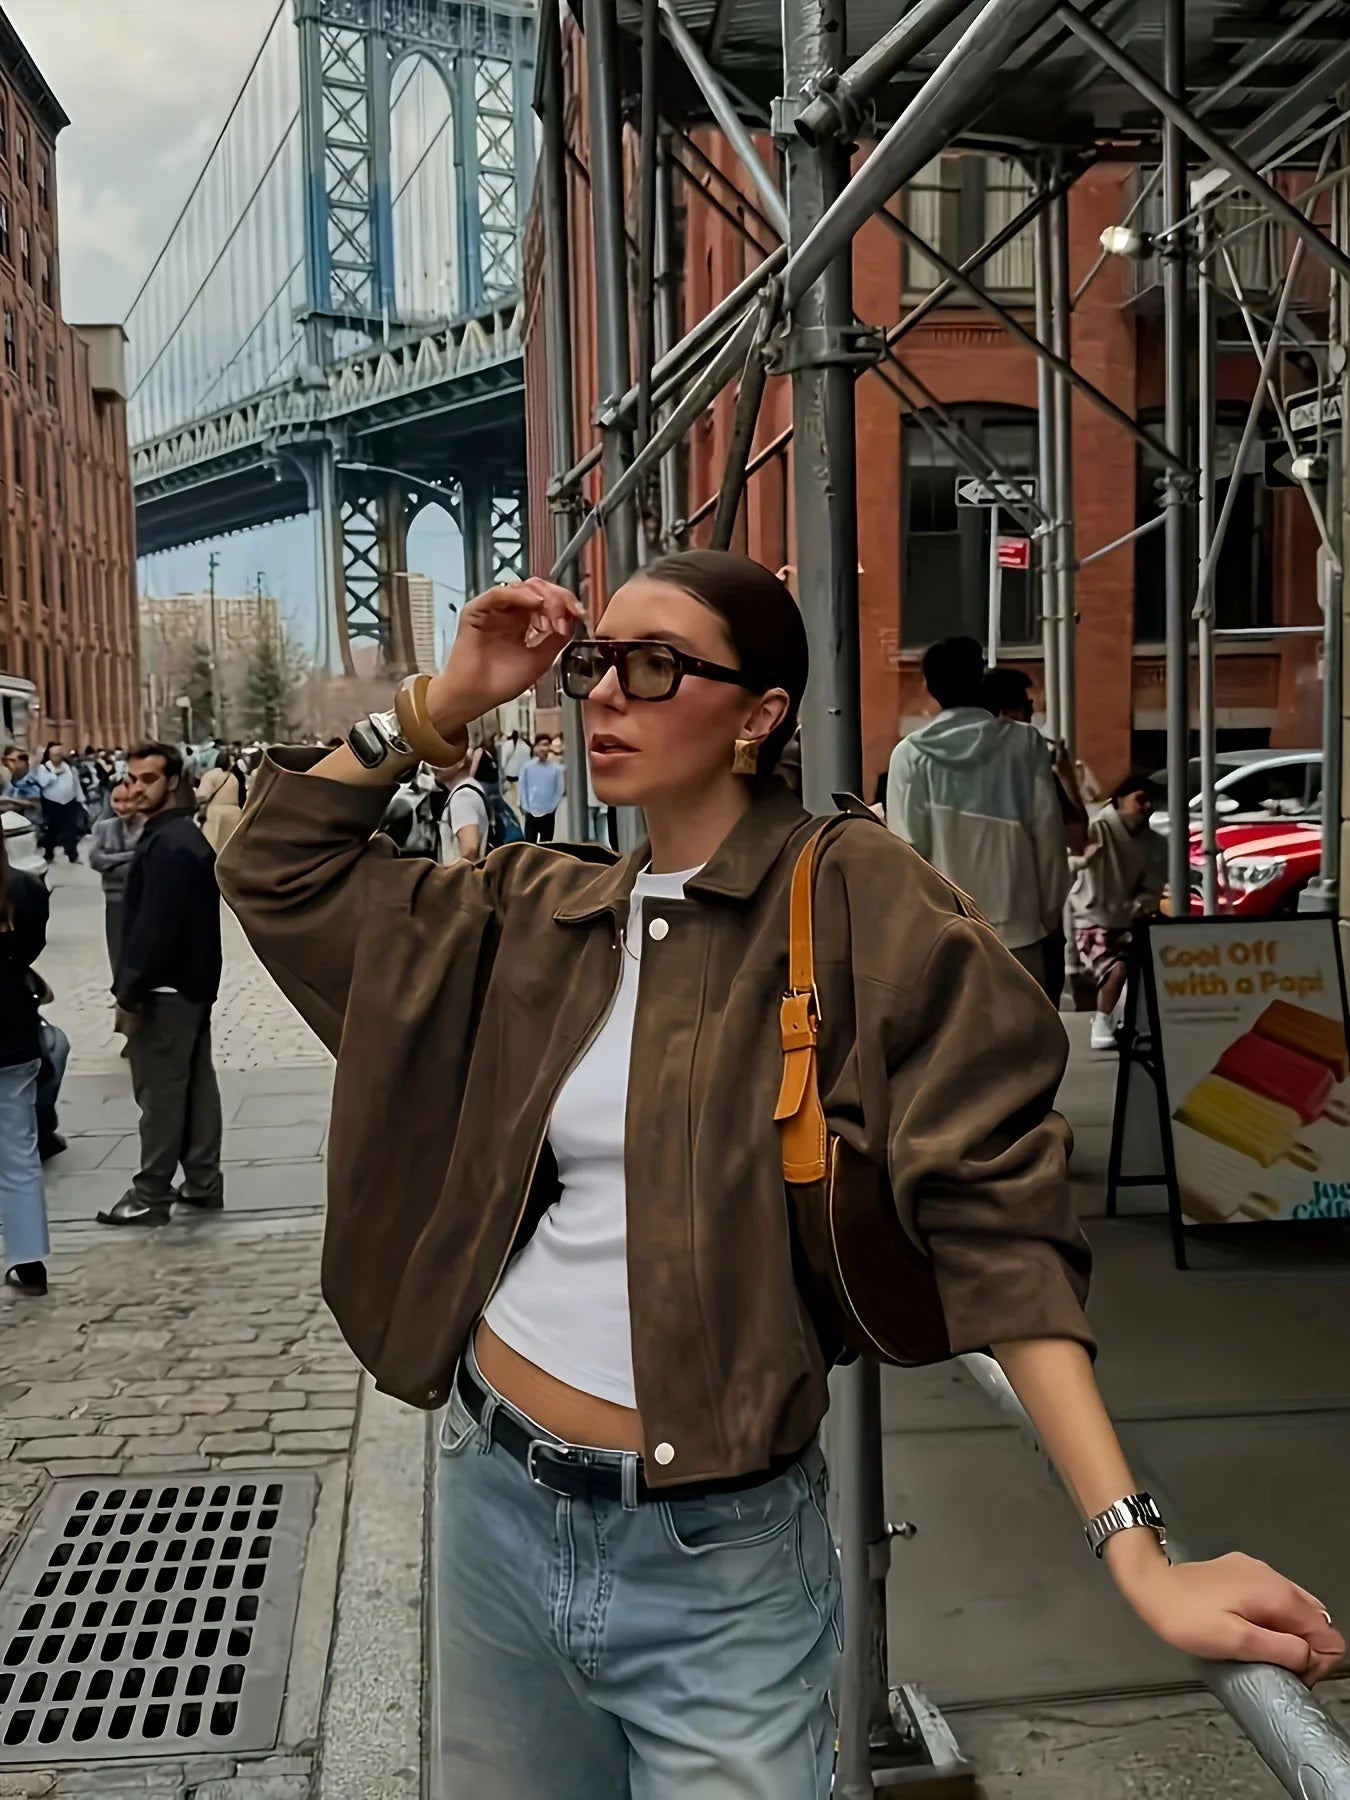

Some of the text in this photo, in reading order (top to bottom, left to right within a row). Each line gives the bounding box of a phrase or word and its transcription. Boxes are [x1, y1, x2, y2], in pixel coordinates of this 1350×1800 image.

[1159, 940, 1278, 968] Cool Off
[1163, 970, 1229, 997] with
[1234, 976, 1254, 994] a
